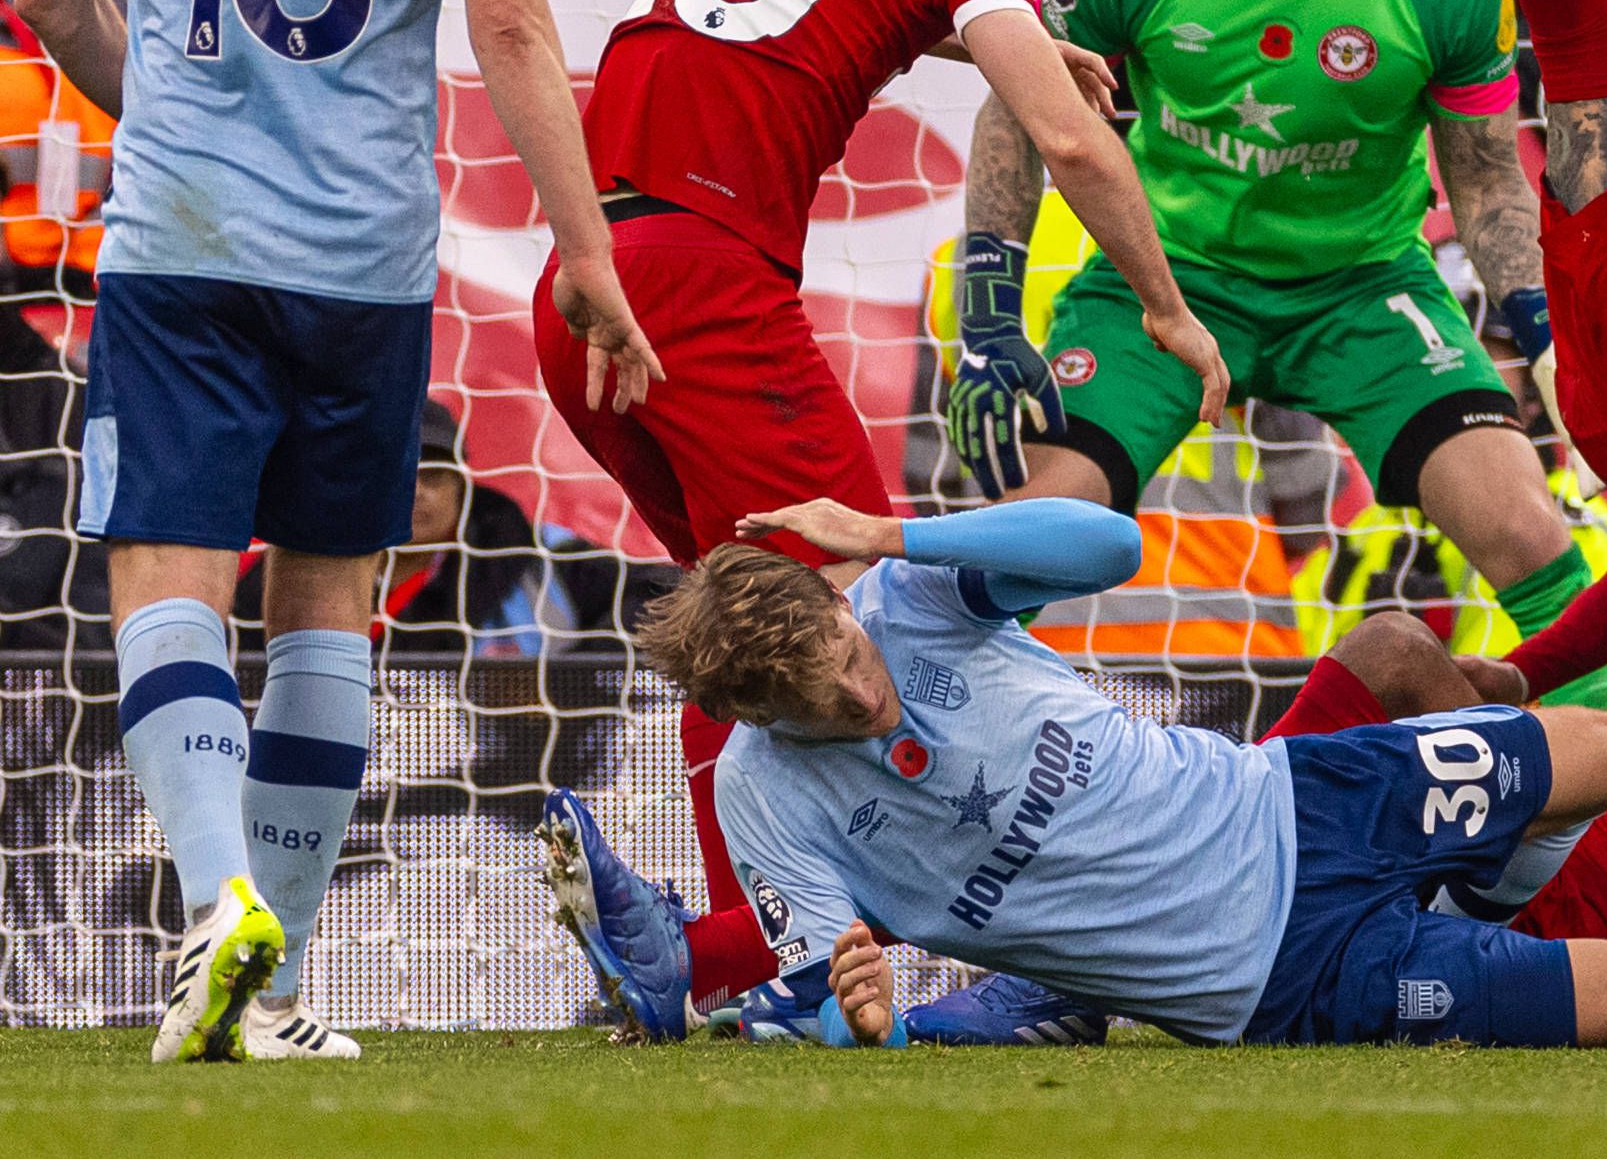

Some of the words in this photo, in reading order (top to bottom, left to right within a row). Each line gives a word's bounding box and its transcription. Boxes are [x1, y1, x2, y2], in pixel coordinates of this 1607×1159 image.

[1161, 103, 1360, 178] HOLLYWOOD
[1385, 292, 1446, 351] 1
[184, 734, 247, 763] 1889
[1067, 740, 1094, 789] bets
[1416, 729, 1494, 838] 30
[1512, 757, 1521, 793] umbro
[253, 820, 323, 852] 1889
[863, 811, 889, 842] umbro
[948, 719, 1074, 932] HOLLYWOOD
